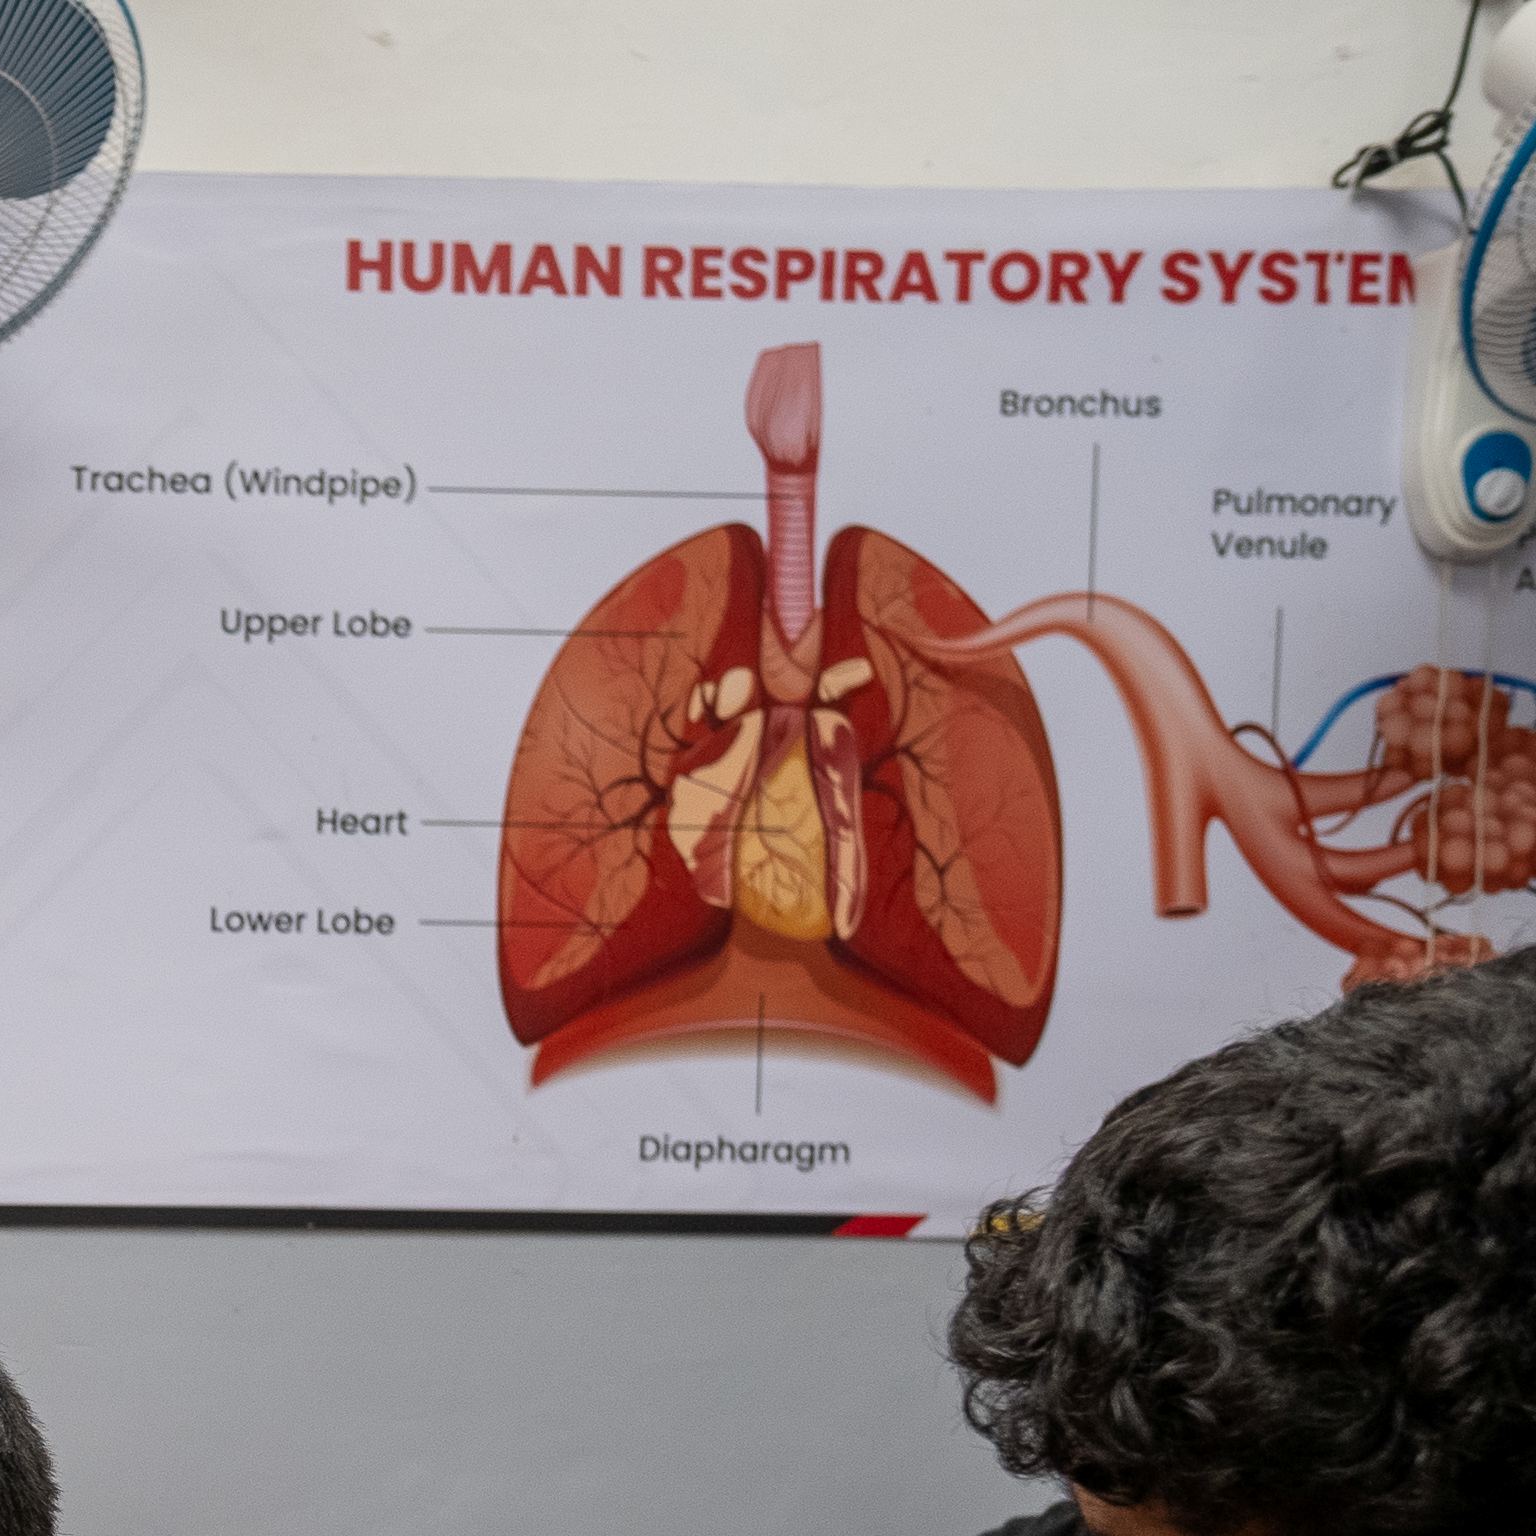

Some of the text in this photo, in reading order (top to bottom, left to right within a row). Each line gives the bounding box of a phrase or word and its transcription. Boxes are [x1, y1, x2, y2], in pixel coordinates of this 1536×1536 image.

[346, 239, 622, 297] HUMAN
[641, 246, 1144, 304] RESPIRATORY
[999, 389, 1162, 418] Bronchus
[71, 460, 417, 506] Trachea (Windpipe)
[1213, 487, 1396, 526] Pulmonary
[1211, 531, 1328, 559] Venule
[220, 608, 412, 643] Upper Lobe
[317, 808, 407, 835] Heart
[210, 906, 395, 936] Lower Lobe
[639, 1133, 851, 1173] Diapharagm
